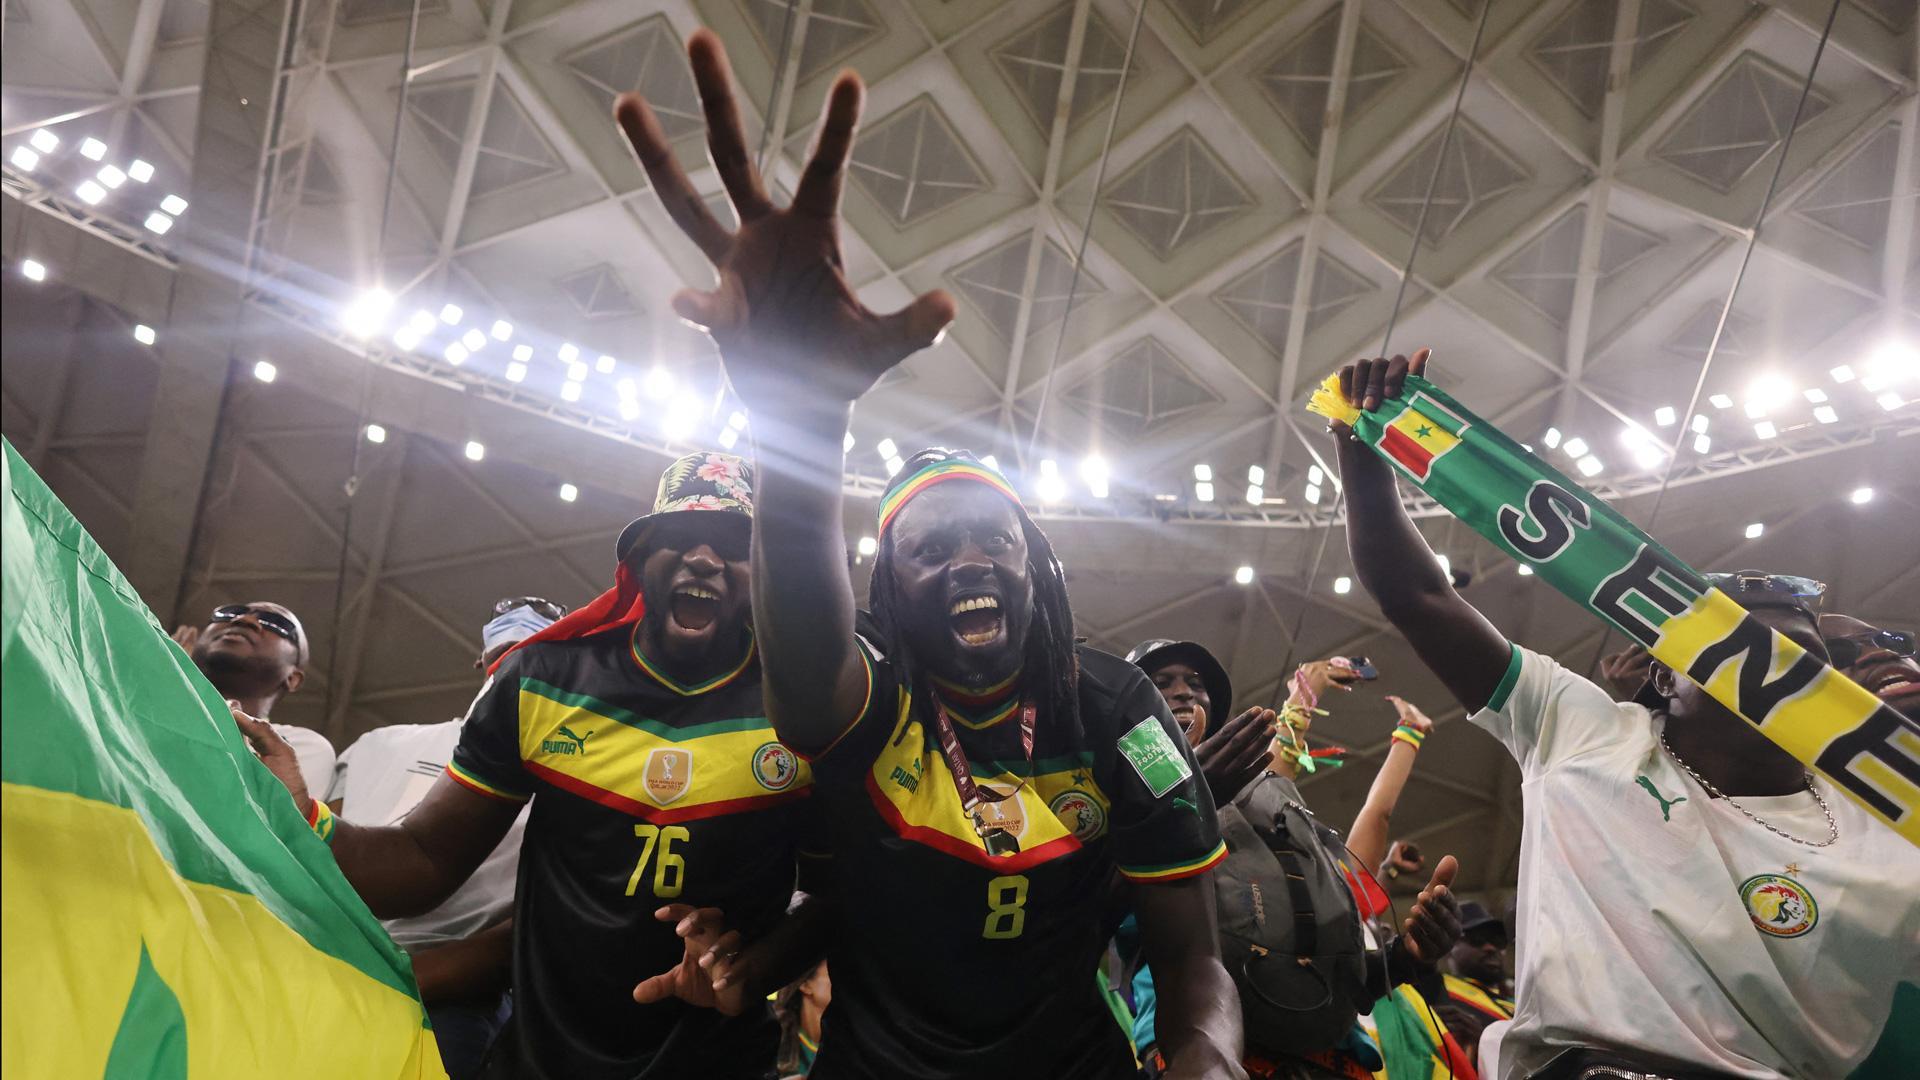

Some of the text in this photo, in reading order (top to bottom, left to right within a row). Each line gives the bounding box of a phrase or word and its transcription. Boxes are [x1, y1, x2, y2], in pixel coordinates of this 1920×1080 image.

[1497, 479, 1919, 823] SENE
[541, 740, 576, 755] PUMA
[624, 823, 690, 898] 76
[982, 874, 1030, 939] 8
